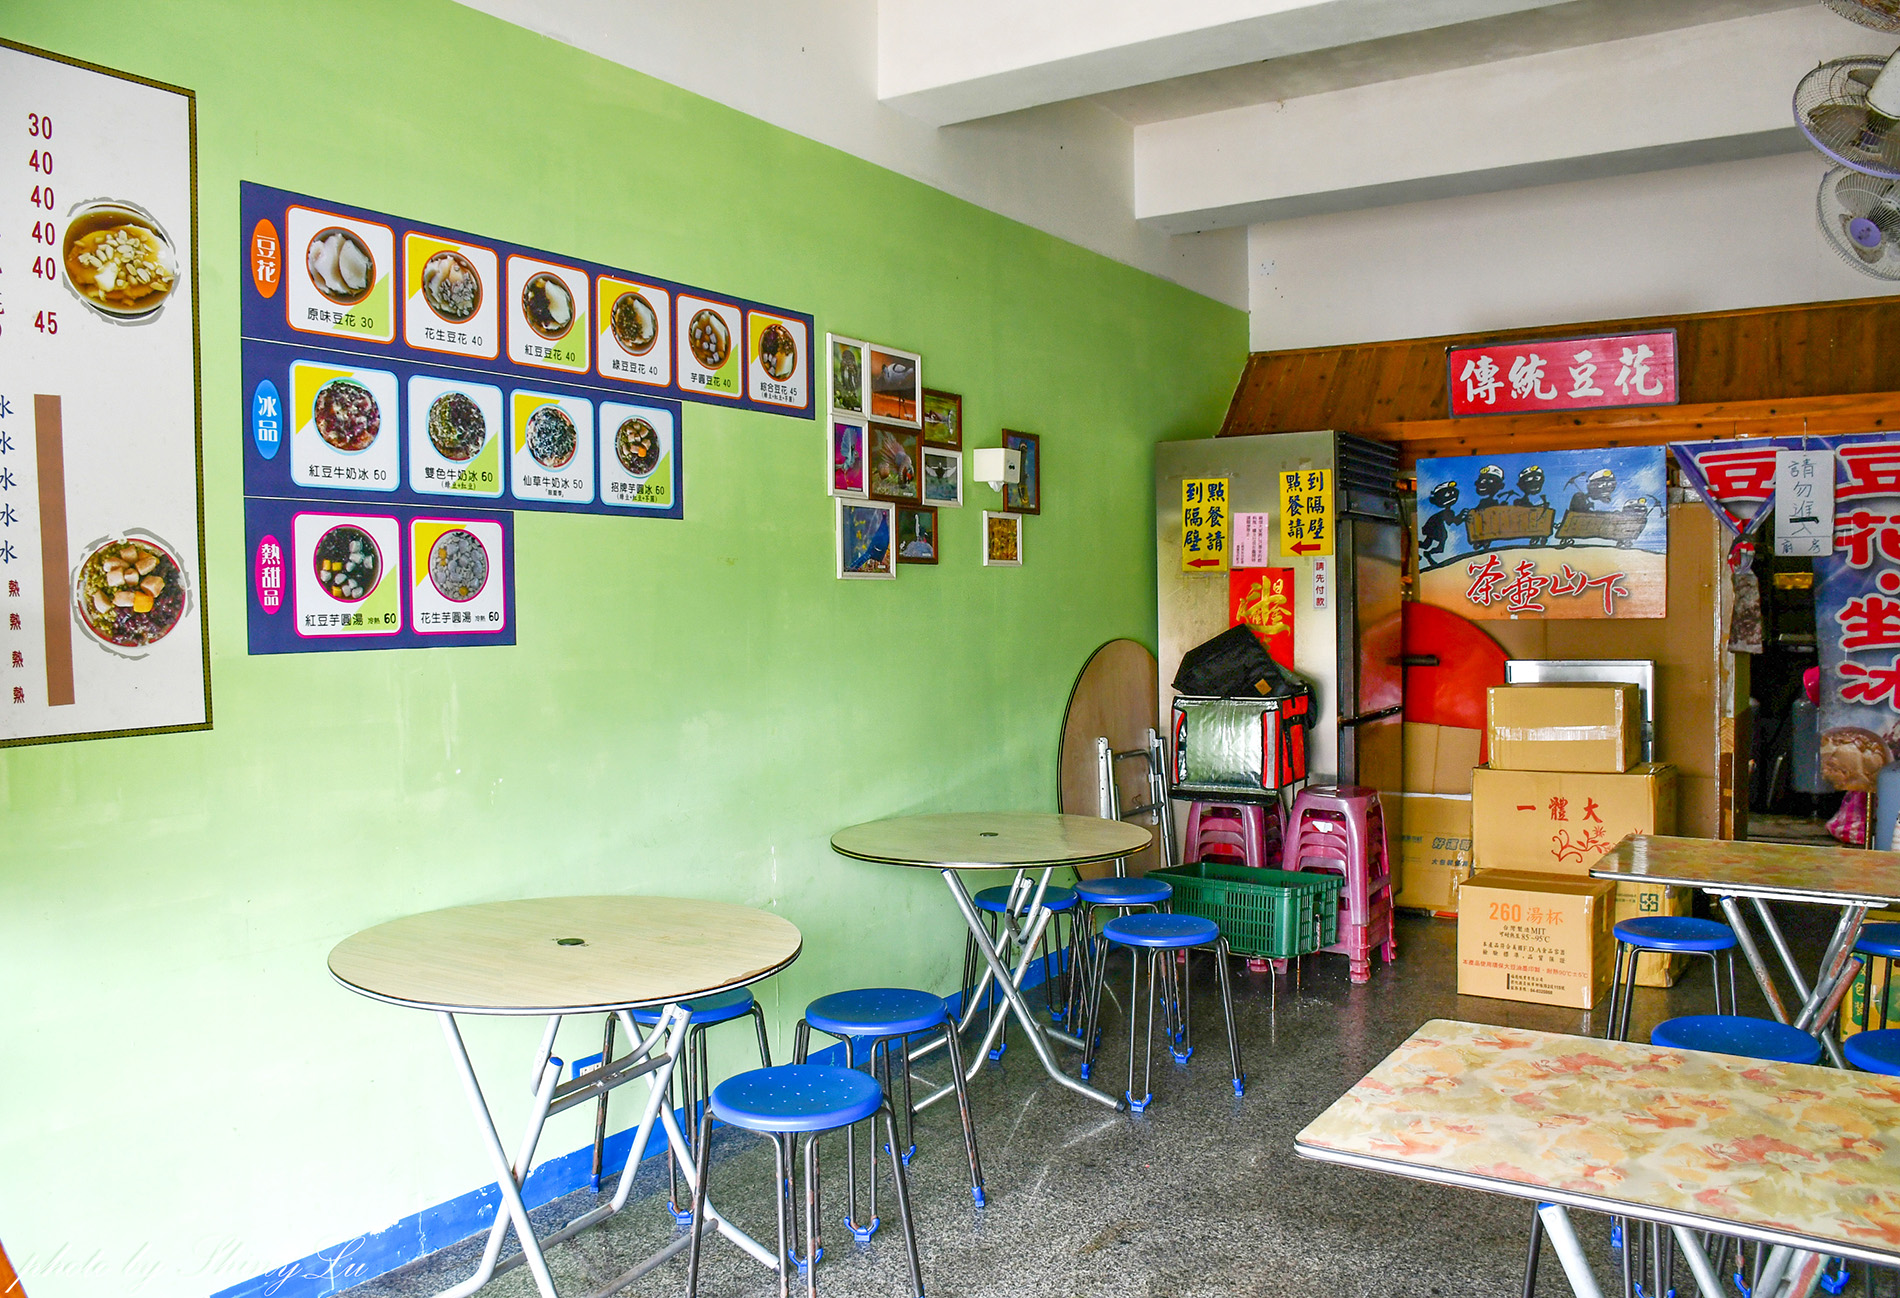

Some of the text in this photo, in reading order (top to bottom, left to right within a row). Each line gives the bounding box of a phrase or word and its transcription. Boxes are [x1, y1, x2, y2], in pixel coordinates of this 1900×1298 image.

[28, 113, 53, 139] 30
[29, 150, 53, 175] 40
[30, 185, 55, 210] 40
[31, 221, 56, 246] 40
[32, 256, 56, 280] 40
[256, 234, 277, 284] 豆花
[34, 311, 58, 335] 45
[307, 307, 374, 329] 原味豆花 30
[425, 327, 483, 346] 花生豆花 40
[524, 344, 576, 362] 紅豆豆花 40
[612, 359, 658, 376] 綠豆豆花 40
[1460, 344, 1664, 405] 傳統豆花
[723, 379, 732, 388] 40
[760, 381, 798, 396] 綜合豆花 45
[258, 395, 278, 442] 冰品
[308, 464, 369, 480] 紅豆牛奶冰
[425, 467, 493, 482] 雙色牛奶冰 60
[523, 475, 583, 489] 仙草牛奶冰 50
[655, 485, 664, 495] 60
[1184, 482, 1203, 552] 到隔壁
[1205, 481, 1225, 552] 點餐請
[1286, 472, 1305, 539] 點餐請
[1307, 471, 1325, 539] 到隔壁
[261, 543, 281, 607] 熱甜品
[1315, 561, 1325, 606] 請先付款
[1466, 554, 1629, 615] 茶壺山下
[305, 613, 364, 627] 紅豆芋圓湯
[384, 613, 397, 624] 60
[420, 612, 472, 624] 花生芋圓湯
[488, 611, 500, 622] 60
[1489, 902, 1563, 926] 260 湯杯
